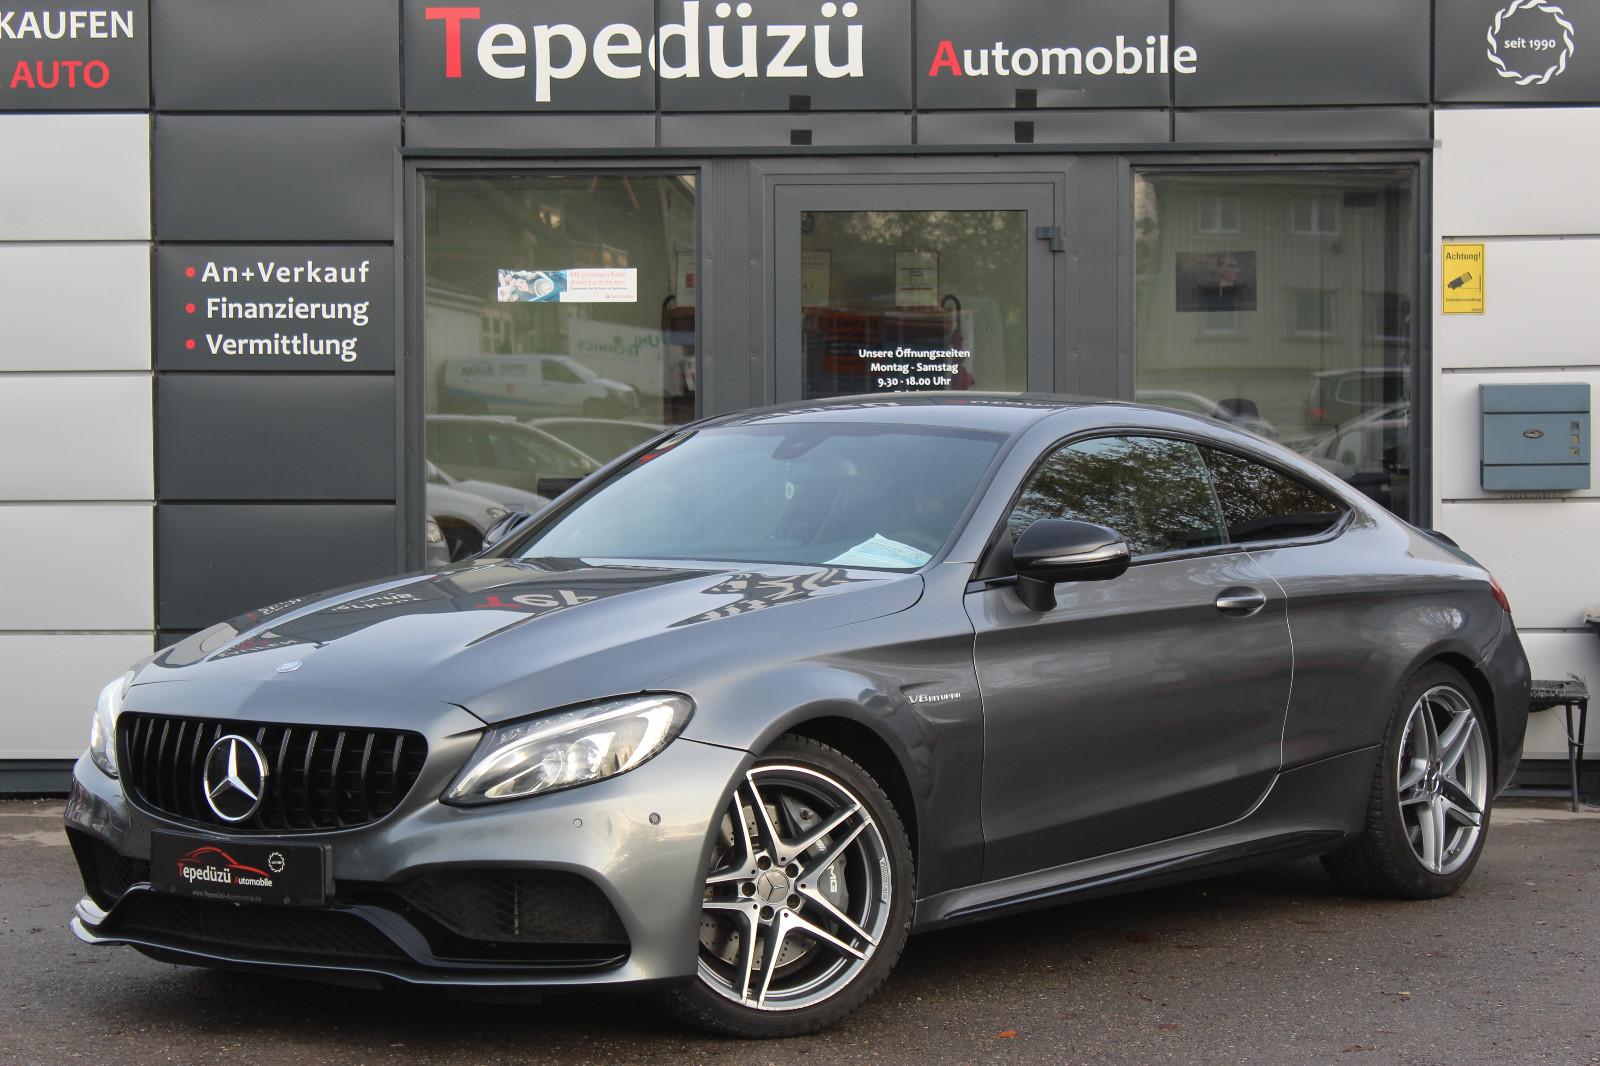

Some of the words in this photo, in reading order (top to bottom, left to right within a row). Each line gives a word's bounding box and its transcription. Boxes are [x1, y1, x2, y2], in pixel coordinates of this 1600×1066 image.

[425, 1, 864, 102] Tepedüzü
[1504, 37, 1526, 49] seit
[1528, 39, 1556, 51] 1990
[928, 35, 1198, 76] Automobile
[10, 60, 109, 89] AUTO
[1446, 252, 1481, 262] Achtung!
[201, 261, 369, 283] An+Verkauf
[207, 297, 369, 326] Finanzierung
[206, 333, 357, 362] Vermittlung
[858, 349, 893, 358] Unsere
[896, 347, 970, 360] Öffnungszeiten
[871, 363, 909, 374] Montag
[917, 363, 958, 374] Samstag
[878, 377, 898, 388] 9.30
[906, 376, 930, 386] 18.00
[933, 376, 951, 386] Uhr
[177, 863, 231, 884] Tepedüzü
[234, 877, 272, 887] Automobile
